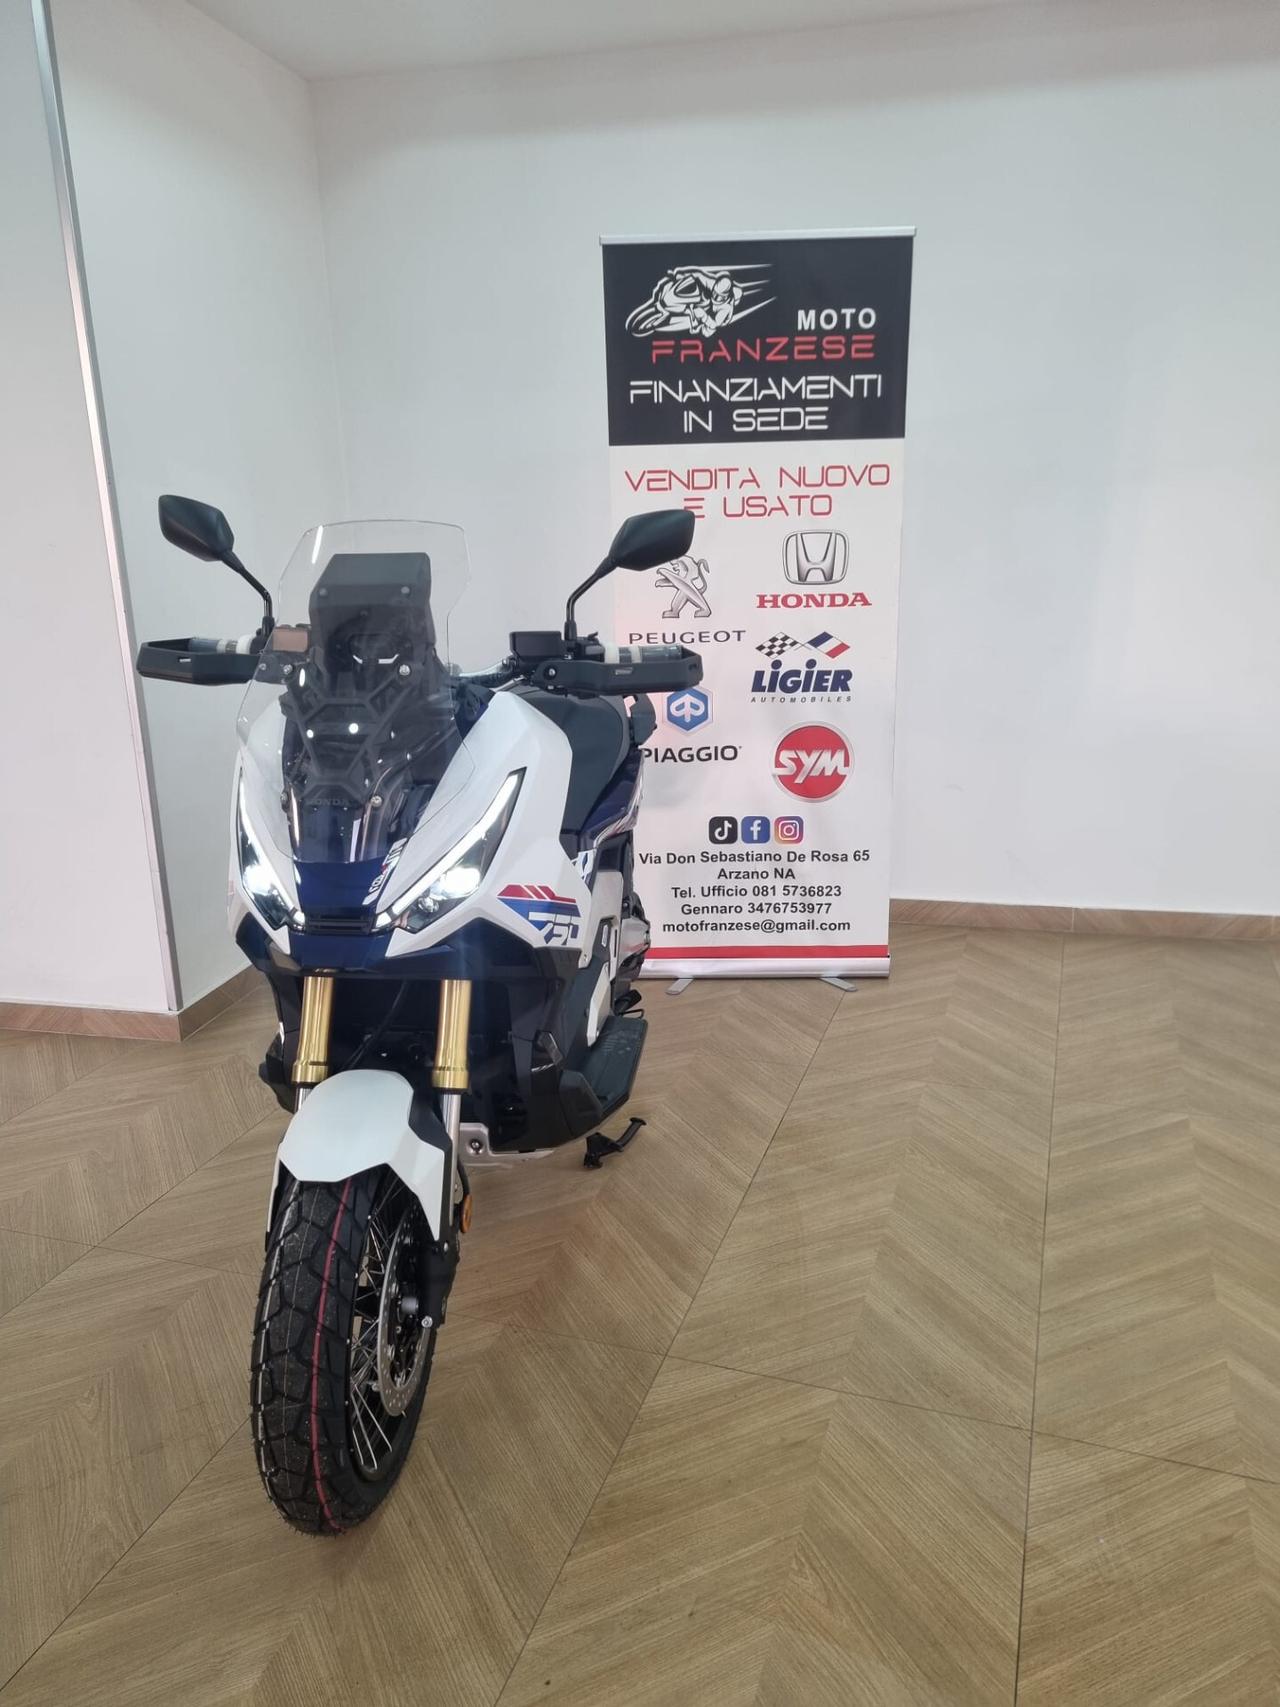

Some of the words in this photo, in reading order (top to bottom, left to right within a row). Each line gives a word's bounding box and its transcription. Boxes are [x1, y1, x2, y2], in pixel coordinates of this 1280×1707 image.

[798, 308, 876, 330] MOTO
[651, 334, 875, 363] FRANZESE
[630, 374, 881, 403] FINANZIAMENTI
[684, 410, 712, 432] IN
[733, 407, 828, 431] SEDE
[625, 468, 760, 491] VENDITA
[780, 464, 889, 488] NUOVO
[683, 498, 705, 518] E
[724, 495, 832, 517] USATO
[756, 592, 872, 609] HONDA
[629, 630, 746, 645] PEUGEOT
[750, 695, 852, 704] AUTOMOBILES
[773, 748, 849, 784] SYM
[639, 853, 661, 864] Via
[667, 853, 695, 864] Don
[701, 851, 781, 862] Sebastiano
[787, 851, 805, 862] De
[811, 851, 848, 862] Rosa
[853, 850, 869, 861] 65
[718, 868, 769, 879] Arzano
[774, 868, 795, 879] NA
[671, 887, 695, 898] Tel.
[701, 886, 747, 897] Ufficio
[753, 886, 775, 896] 081
[783, 885, 841, 897] 5736823
[681, 904, 742, 915] Gennaro
[747, 903, 832, 914] 3476753977
[663, 919, 850, 933] motofranzese@gmail.com
